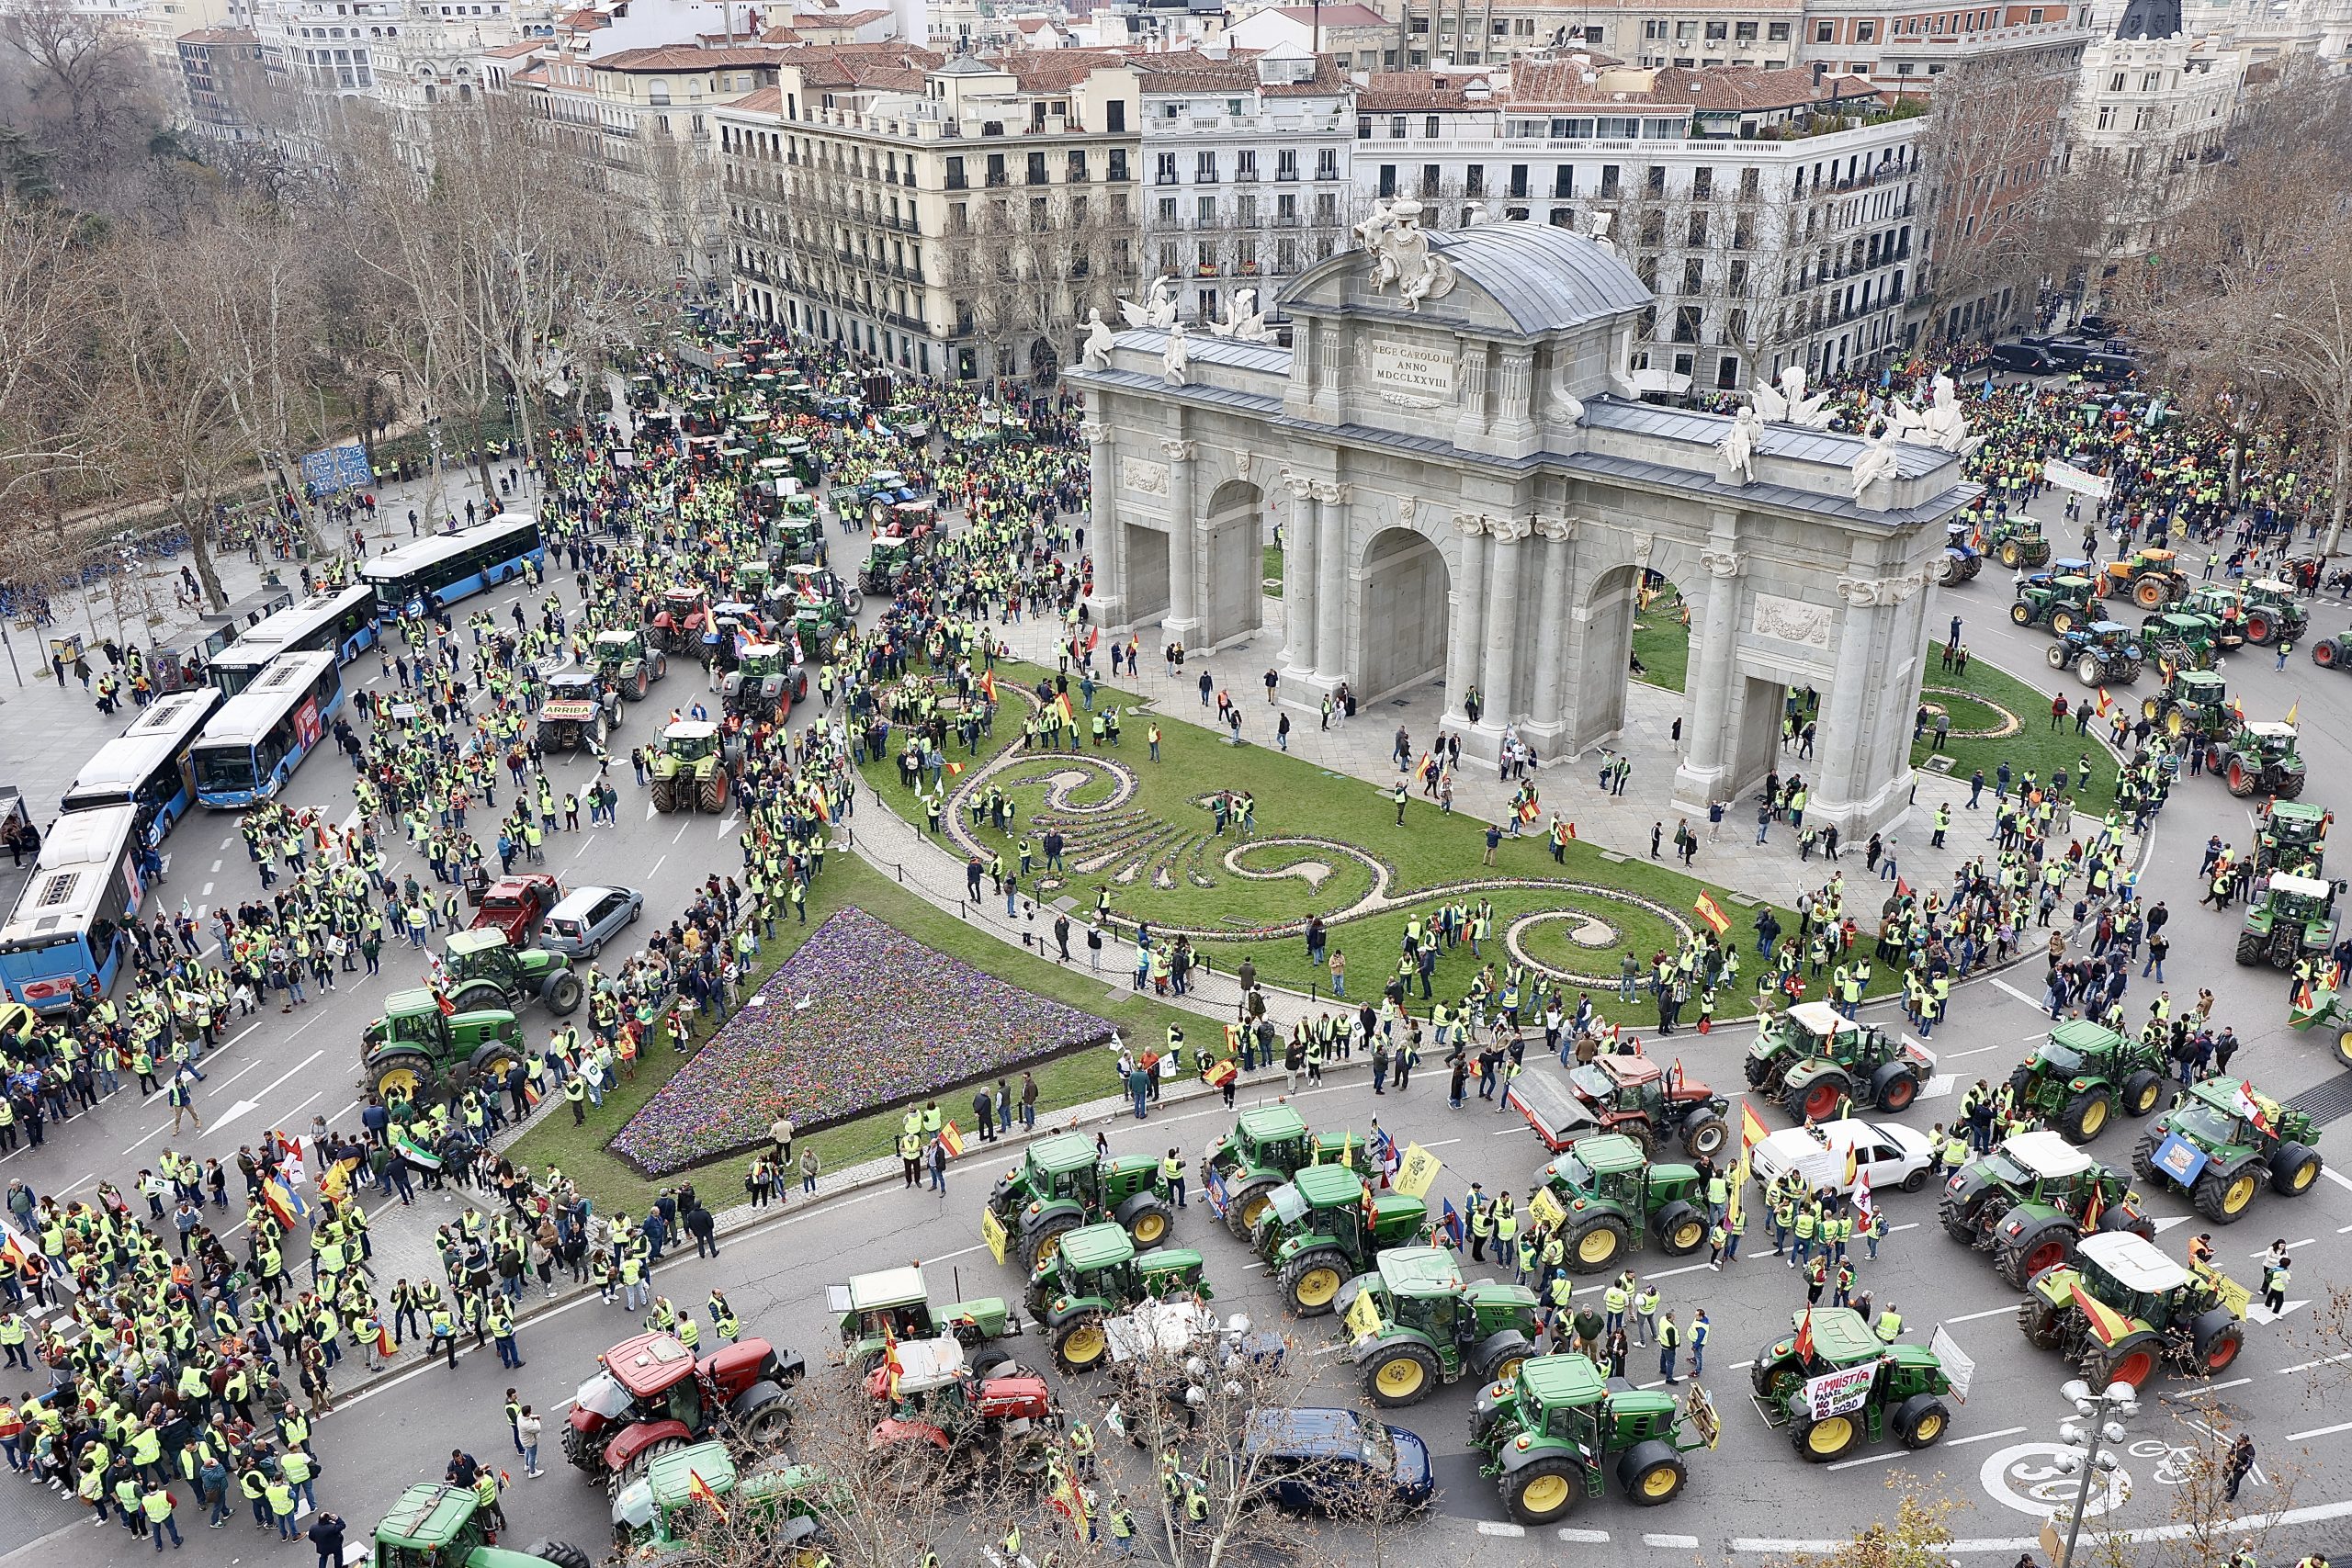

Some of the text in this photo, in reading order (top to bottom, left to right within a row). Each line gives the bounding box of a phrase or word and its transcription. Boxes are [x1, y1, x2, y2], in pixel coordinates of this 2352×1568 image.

[1373, 344, 1453, 365] REGE CAROLO III
[1396, 360, 1427, 373] ANNO
[1376, 369, 1447, 388] MDCCLXXVIII
[306, 446, 365, 469] AGENA 2030
[1815, 1401, 1830, 1410] NO
[1815, 1399, 1859, 1418] NO 2030
